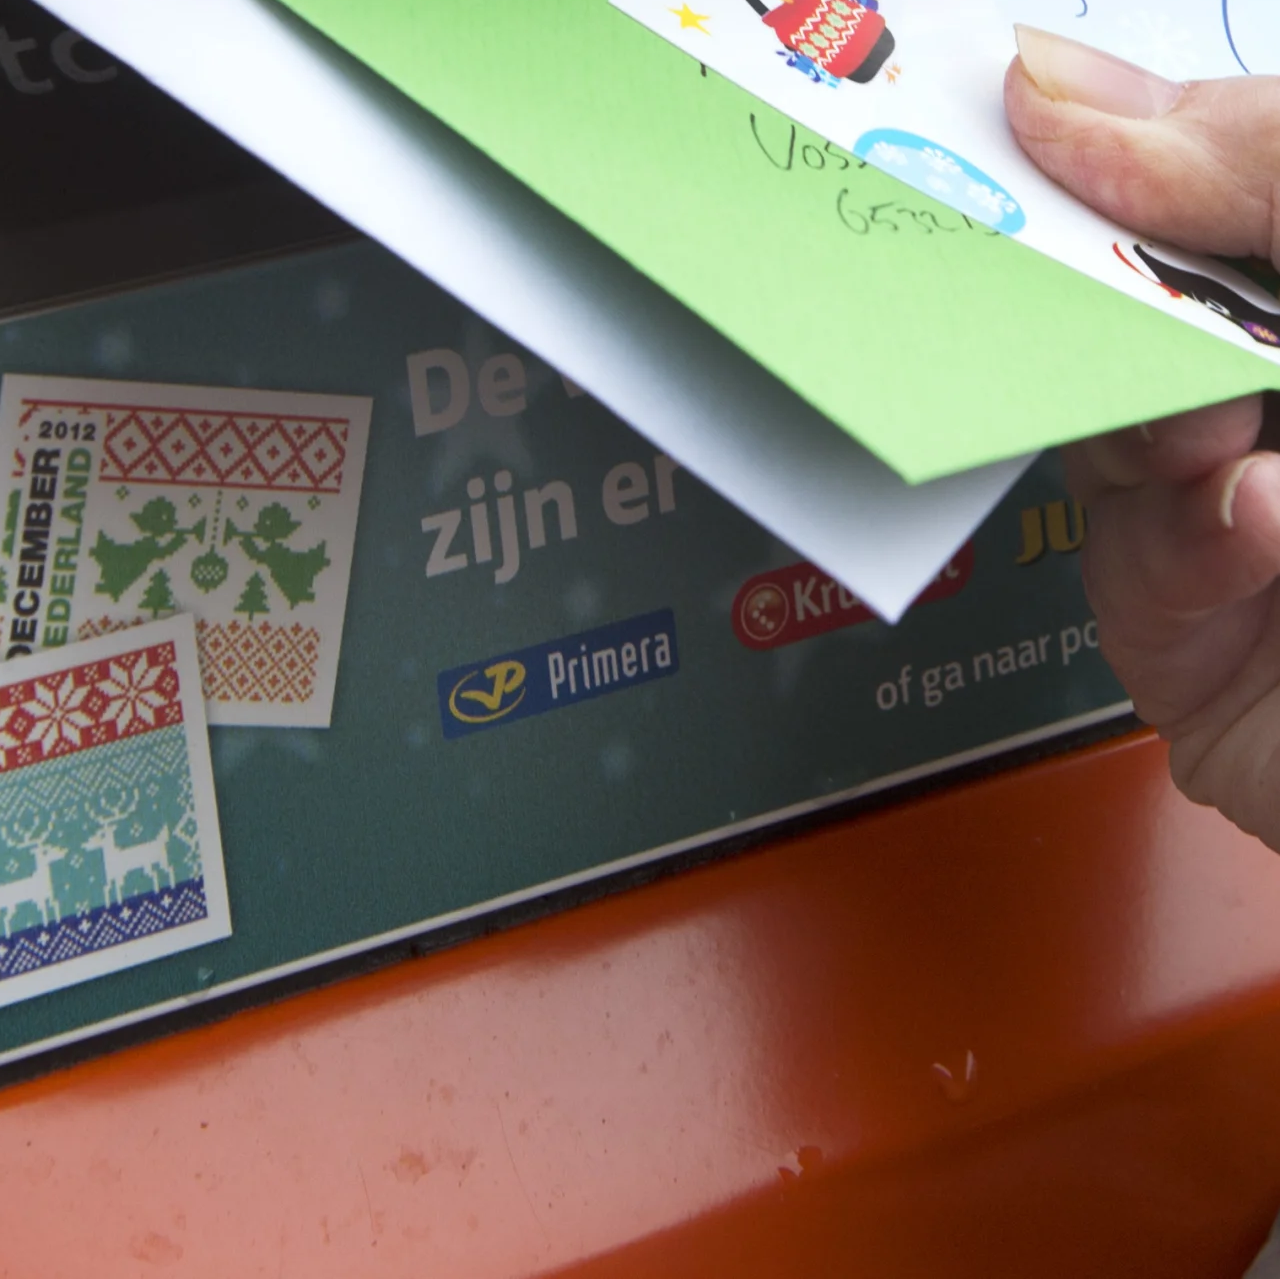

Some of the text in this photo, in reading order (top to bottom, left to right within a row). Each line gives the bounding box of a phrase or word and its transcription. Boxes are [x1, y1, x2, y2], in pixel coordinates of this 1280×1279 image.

[749, 112, 868, 171] Vos
[38, 420, 97, 442] 2012
[406, 347, 528, 438] De
[42, 446, 93, 648] EDERLAND
[420, 454, 681, 585] zijn er
[547, 632, 672, 700] Primera
[875, 664, 912, 711] of
[921, 662, 965, 708] ga
[972, 632, 1051, 683] naar
